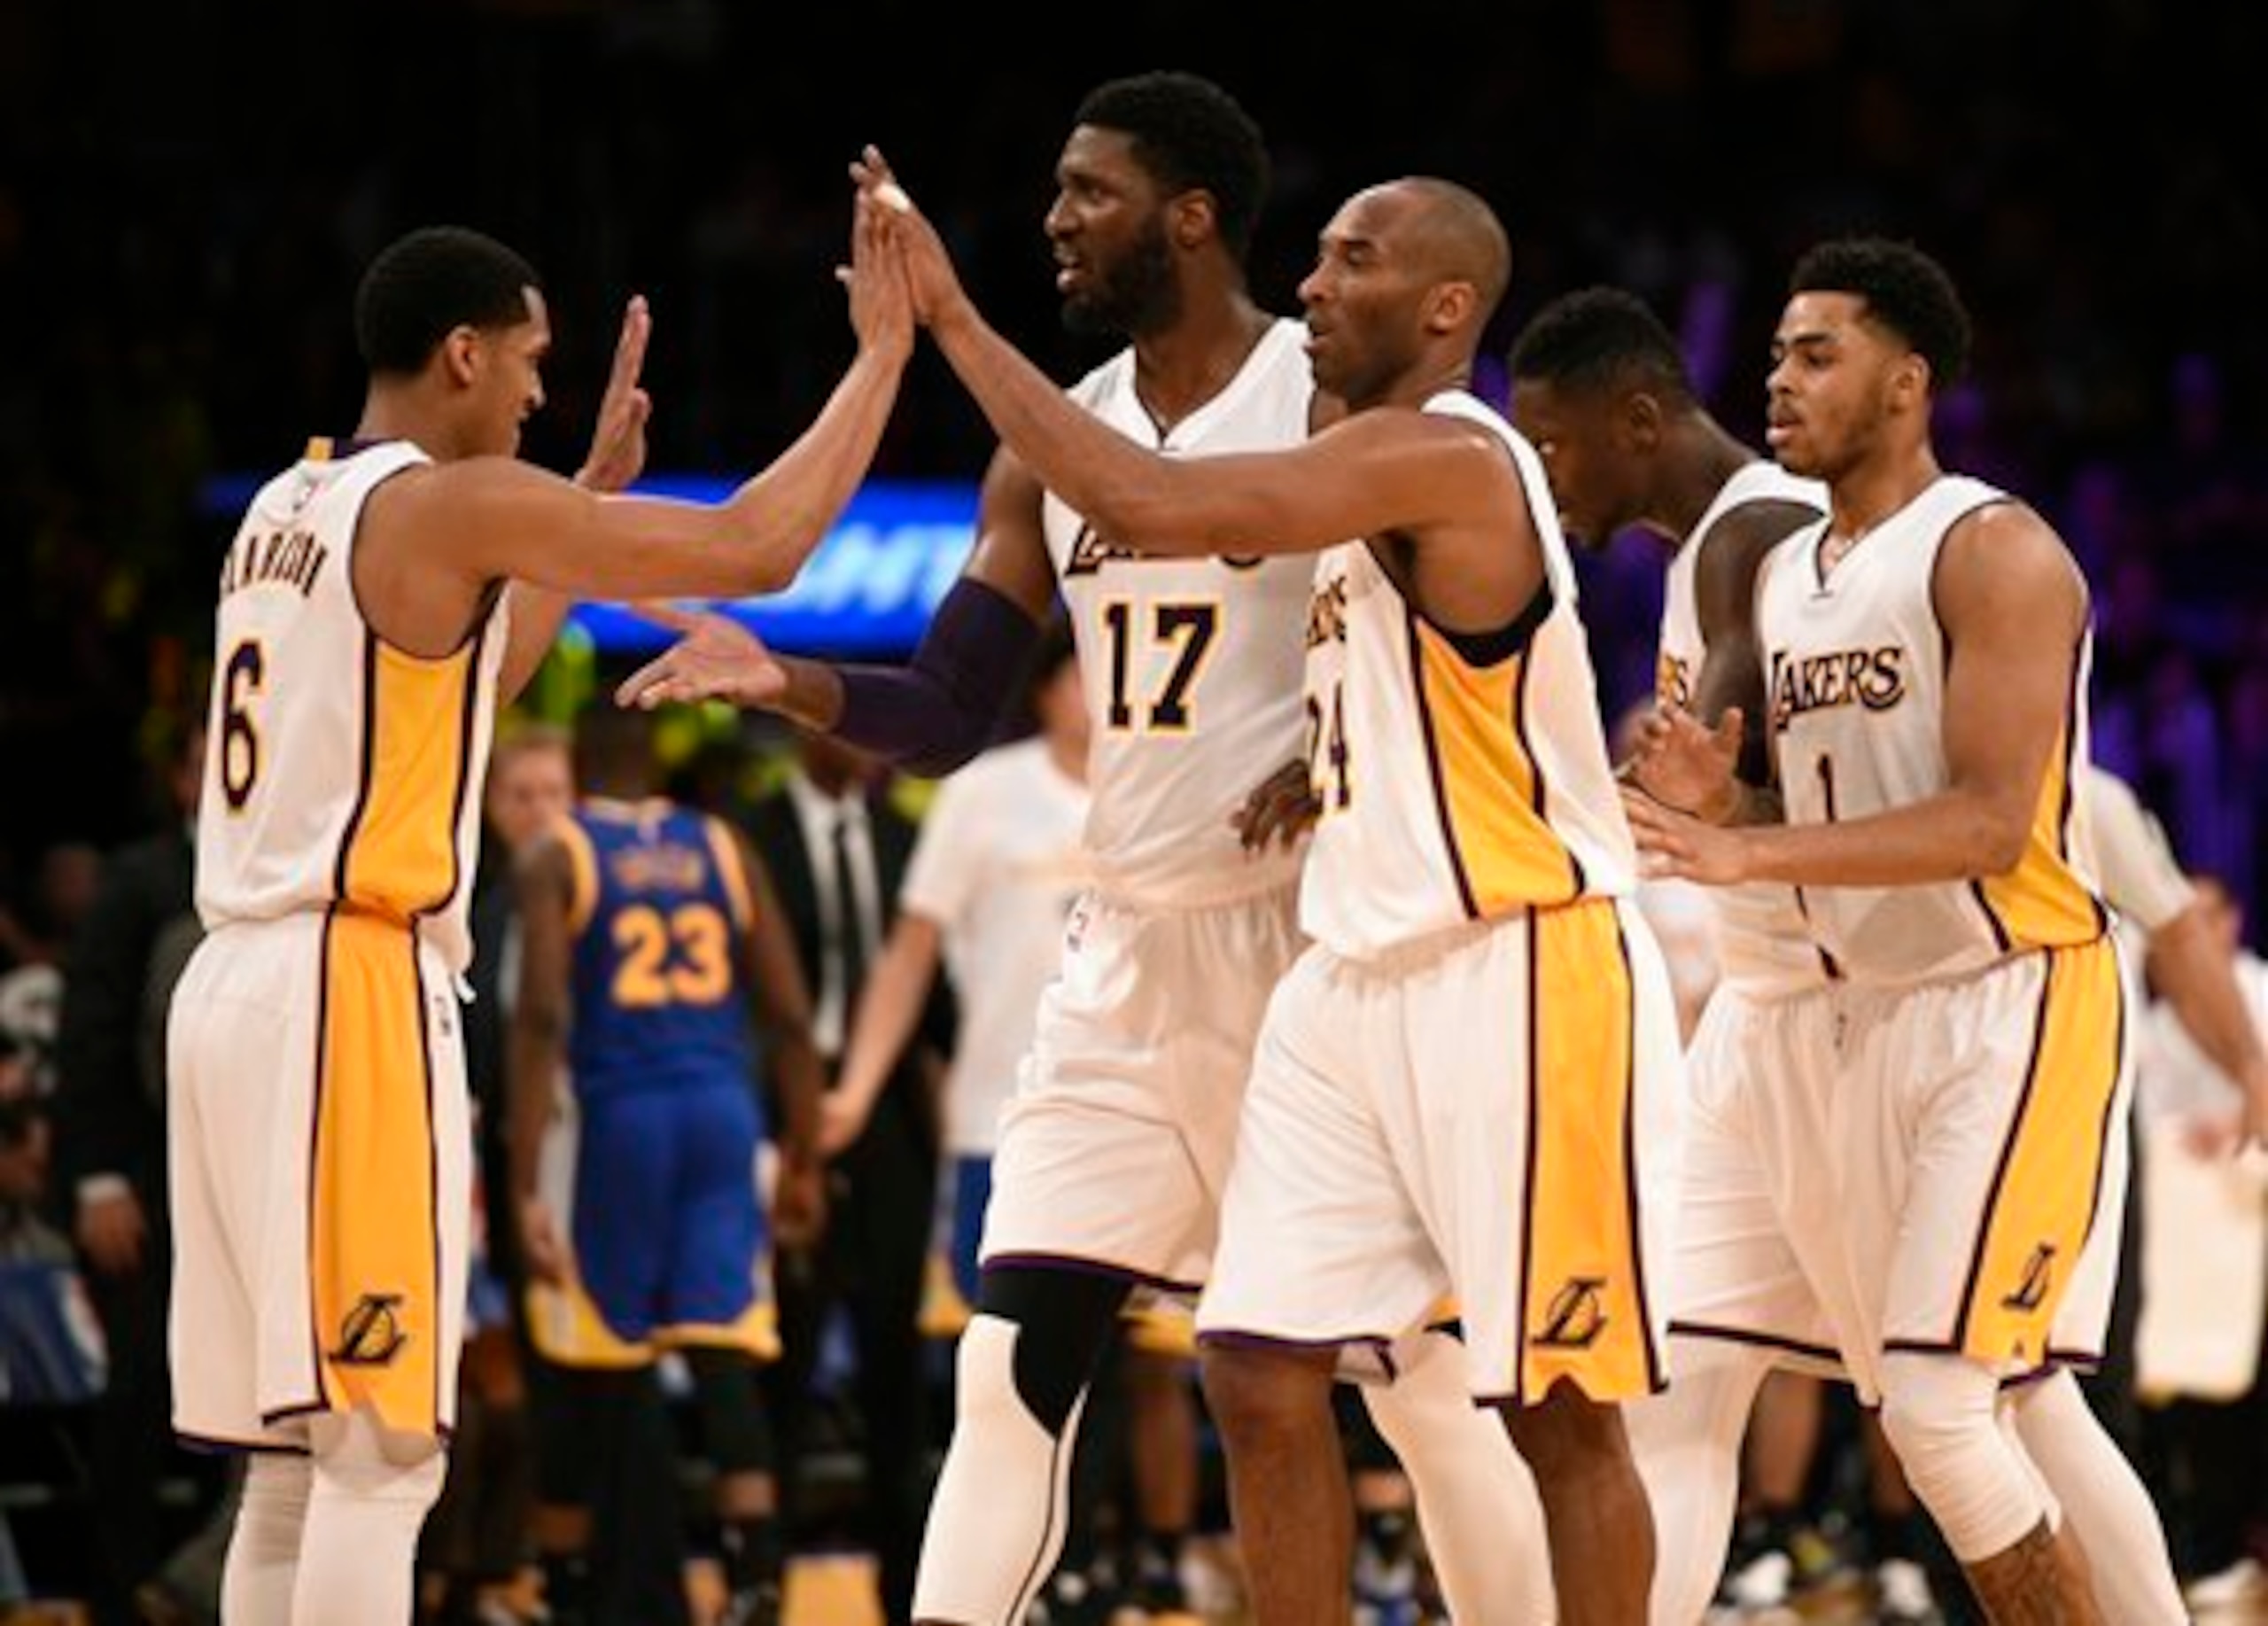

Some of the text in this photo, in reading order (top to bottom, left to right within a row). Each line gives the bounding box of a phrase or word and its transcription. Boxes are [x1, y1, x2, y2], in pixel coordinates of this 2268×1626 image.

[223, 637, 262, 810] 6
[1103, 602, 1219, 728] 17
[611, 902, 732, 1008] 23
